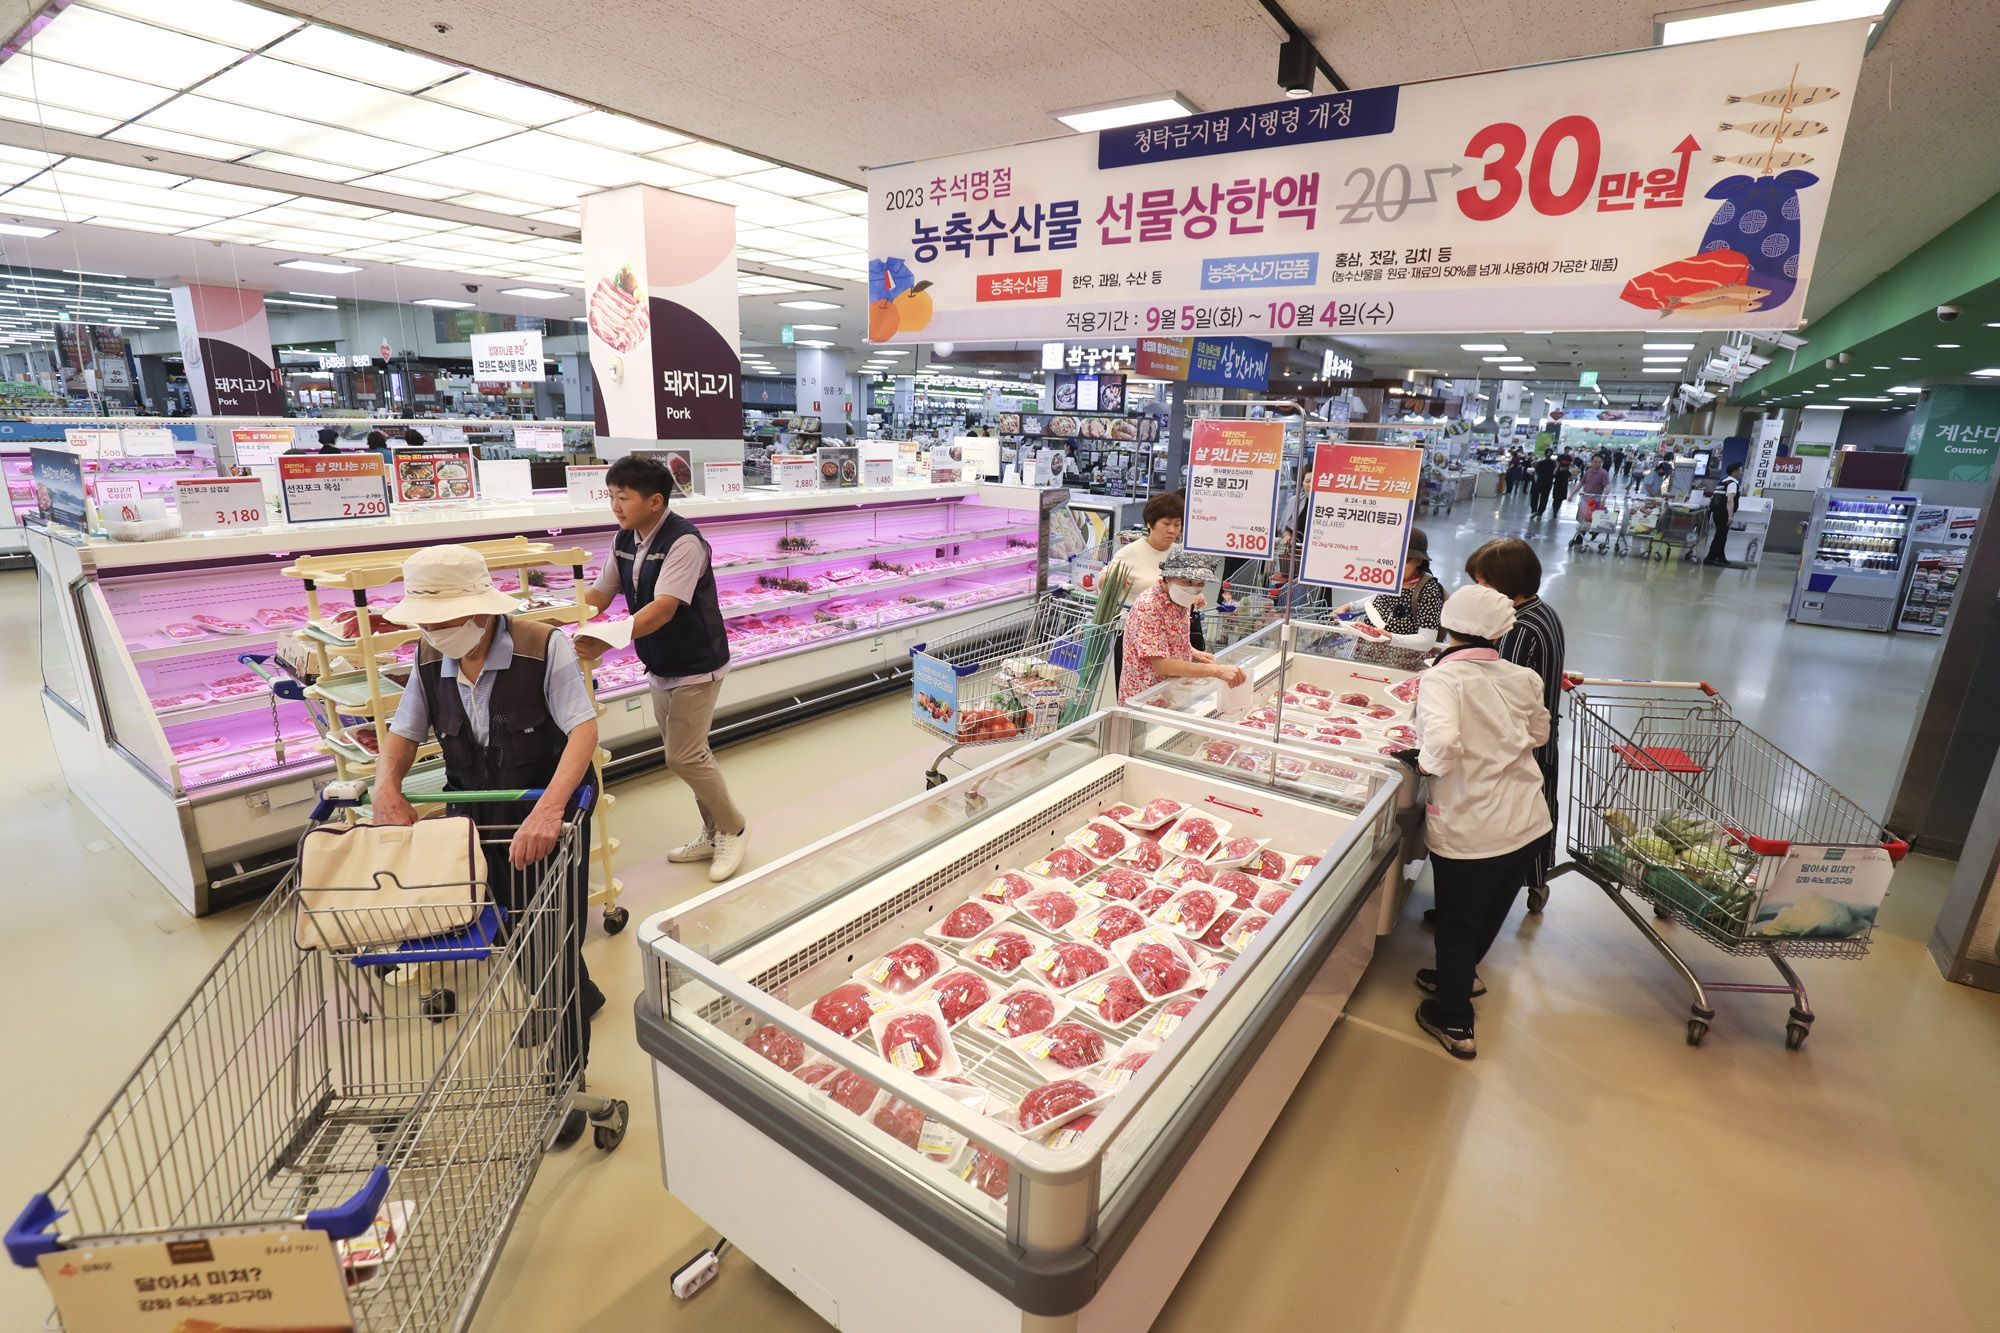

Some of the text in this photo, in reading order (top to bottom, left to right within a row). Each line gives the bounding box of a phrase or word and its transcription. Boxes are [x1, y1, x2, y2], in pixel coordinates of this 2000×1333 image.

[1135, 99, 1354, 153] 청탁금지법 시행령 개정
[885, 166, 1013, 211] 2023 추석명절
[911, 199, 1082, 264] 농축수산물
[1095, 171, 1320, 246] 선물상한액
[1456, 114, 1688, 222] 30만원
[1334, 247, 1452, 268] 홍삼, 젓갈, 김치 등
[1207, 259, 1311, 285] 농축수산가공품
[1331, 266, 1383, 283] (농수산물을
[1443, 261, 1477, 278] 50%를
[1478, 261, 1500, 277] 넘게
[1503, 259, 1549, 276] 사용하여
[1551, 257, 1587, 274] 가공한
[1588, 255, 1618, 273] 제품)
[990, 274, 1048, 296] 농축수산물
[1072, 269, 1163, 289] 한우, 과일, 수산 등
[1065, 312, 1129, 333] 적용기간
[1145, 305, 1177, 331] 9월
[1180, 304, 1244, 331] 5일(화)
[1268, 302, 1315, 329] 10월
[1319, 300, 1395, 329] 4일(수)
[478, 358, 537, 373] 브랜드 축산물 행사장
[215, 376, 272, 394] 돼지고기
[663, 370, 734, 399] 돼지고기
[218, 397, 239, 407] Pork
[666, 407, 692, 420] Pork
[1222, 430, 1247, 438] 대한민국
[1226, 438, 1254, 447] 살맛나게!
[1944, 445, 1988, 455] Counter
[1194, 447, 1278, 465] 살 맛나는 가격!
[1349, 455, 1378, 465] 대한민국
[315, 461, 379, 473] 살 맛나는 가격!
[1353, 464, 1386, 474] 살맛나게!
[287, 482, 341, 493] 선진포크 목심
[721, 483, 741, 494] 1,390
[795, 479, 813, 489] 2,880
[876, 476, 890, 485] 1,480
[1193, 475, 1249, 491] 한우 불고기
[1317, 472, 1413, 495] 살 맛나는 가격!
[180, 486, 208, 495] 선진포크
[589, 489, 609, 501] 1,39
[216, 509, 259, 525] 3,180
[342, 501, 386, 517] 2,290
[1315, 505, 1402, 526] 한우 국거리(1등급)
[1225, 532, 1267, 551] 3,180
[1334, 543, 1349, 551] 200kg
[1343, 563, 1395, 586] 2,880
[1800, 863, 1828, 873] 달아서
[1795, 876, 1853, 885] 강화 속노랑고구마
[134, 1267, 263, 1293] 달아서 미쳐?
[137, 1288, 273, 1312] 강화 속노랑고구마
